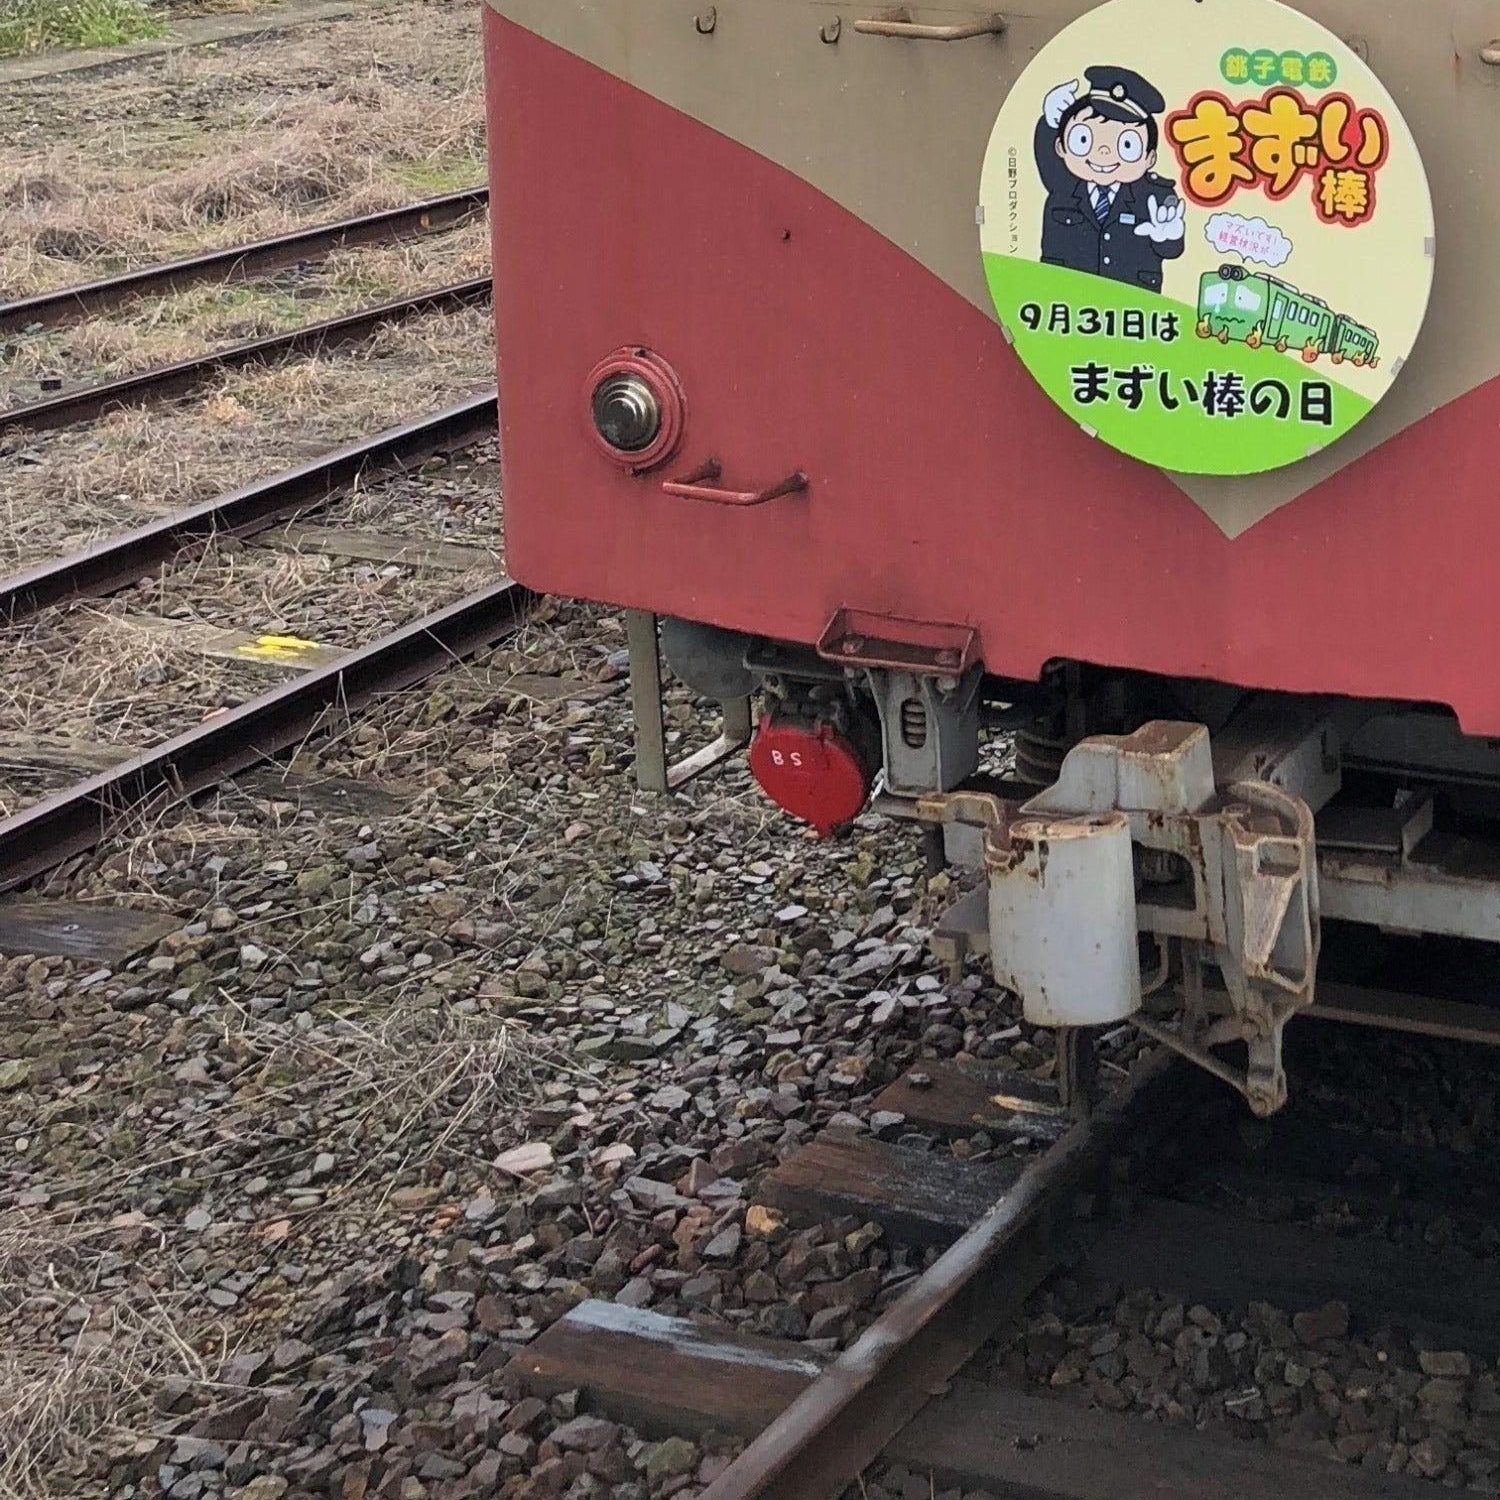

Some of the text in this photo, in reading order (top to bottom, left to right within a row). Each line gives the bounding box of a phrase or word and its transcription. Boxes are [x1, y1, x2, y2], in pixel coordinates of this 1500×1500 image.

[1225, 54, 1332, 83] 銚子電鉄
[1169, 89, 1386, 200] まずい
[1317, 166, 1372, 221] 棒
[1018, 302, 1180, 343] 9月31日は
[1069, 361, 1335, 427] まずい棒の日
